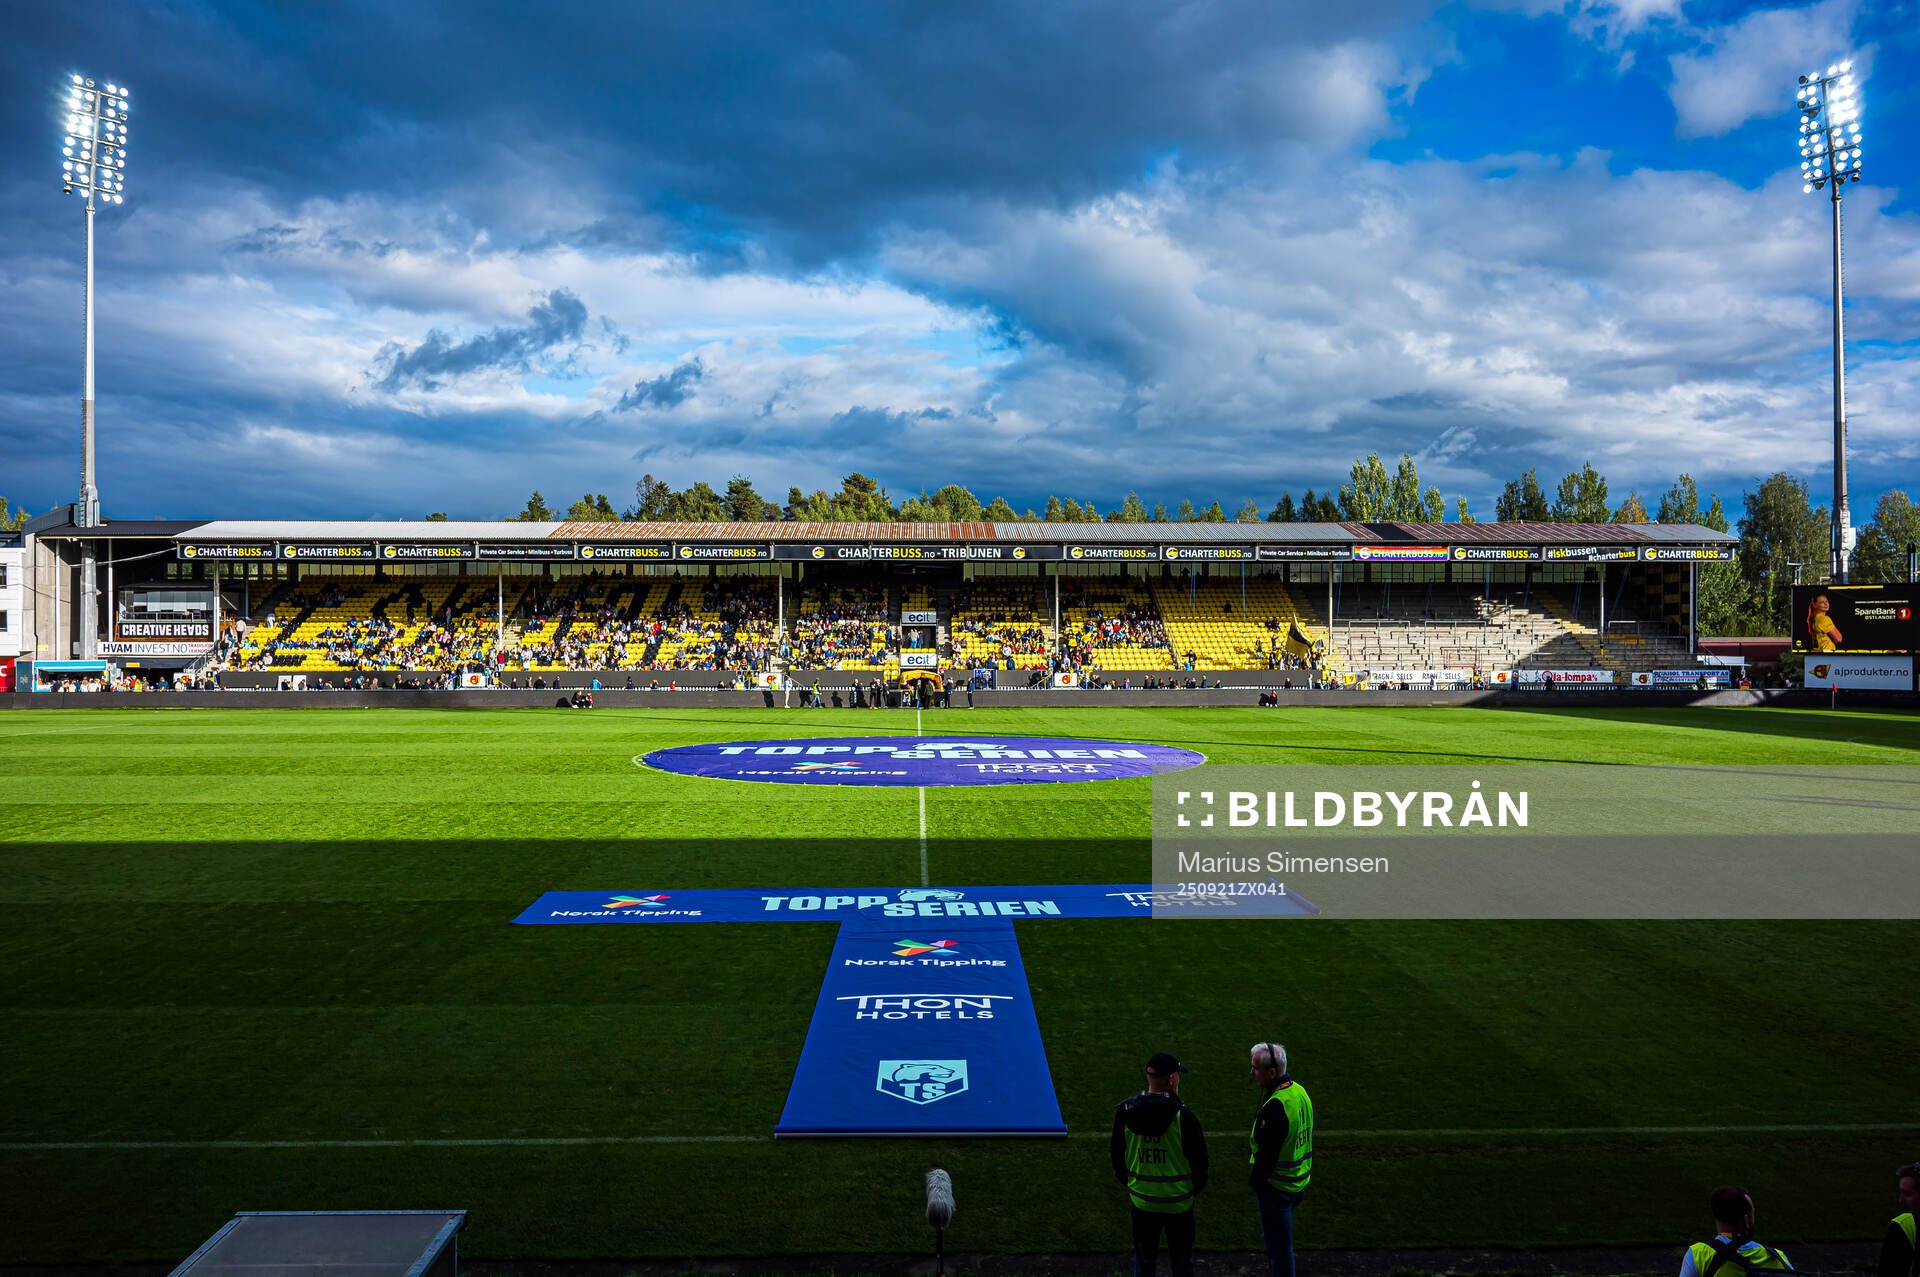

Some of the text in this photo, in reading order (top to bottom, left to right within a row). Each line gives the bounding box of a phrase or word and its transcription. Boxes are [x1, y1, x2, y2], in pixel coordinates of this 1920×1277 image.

[197, 547, 273, 557] CHARTERBUSS.no
[297, 547, 372, 557] CHARTERBUSS.no
[398, 547, 472, 557] CHARTERBUSS.no
[595, 548, 669, 557] CHARTERBUSS.no
[694, 548, 767, 557] CHARTERBUSS.no
[1084, 549, 1157, 558] CHARTERBUSS.no
[1179, 549, 1252, 558] CHARTERBUSS.no
[1467, 549, 1539, 559] CHARTERBUSS.no
[1658, 549, 1729, 559] CHARTERBUSS.no
[908, 611, 930, 622] ecit
[1855, 607, 1896, 616] SpareBank
[122, 624, 172, 636] CREATIVE
[103, 643, 188, 653] HVAM INVEST.NO
[907, 654, 930, 665] ecit
[1834, 667, 1909, 677] ajprodukter.no
[718, 746, 1148, 759] TOPP SERIEN
[761, 895, 1062, 918] TOPP SERIEN
[622, 909, 703, 917] Tipping
[845, 958, 1006, 968] Norsk Tipping
[836, 994, 1013, 1010] THON
[856, 1010, 994, 1020] HOTELS
[1138, 1148, 1168, 1164] VERT
